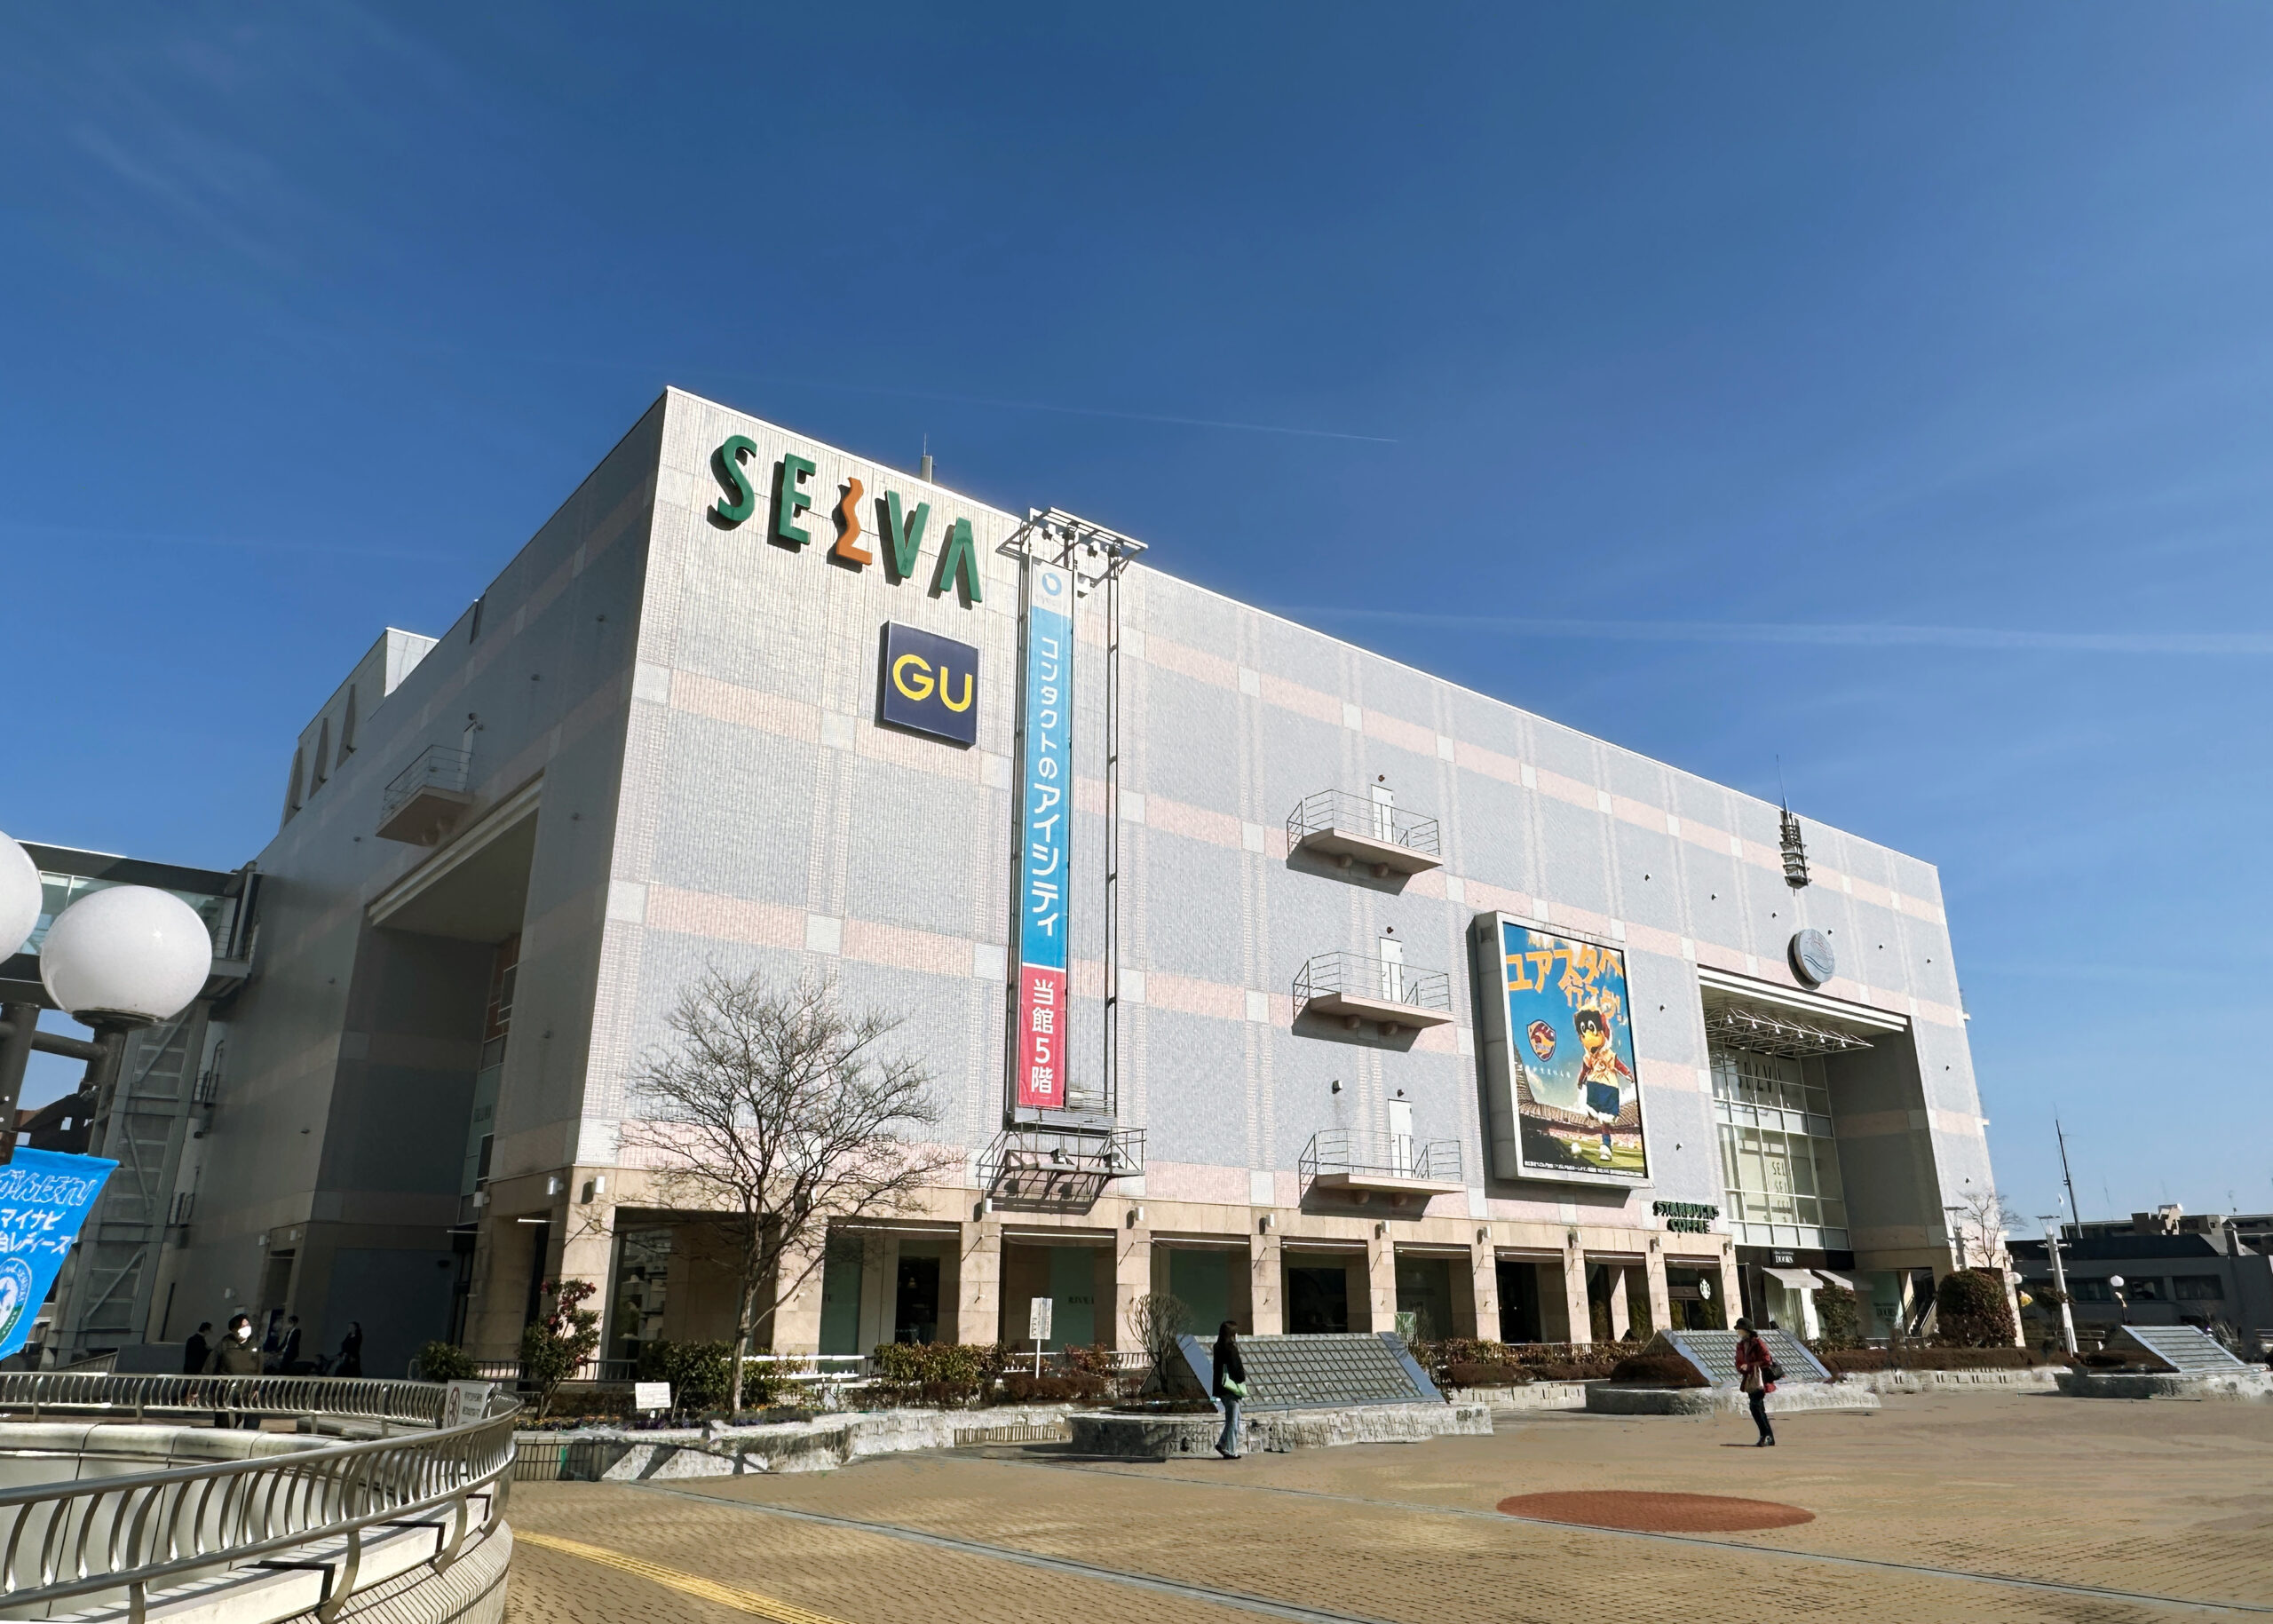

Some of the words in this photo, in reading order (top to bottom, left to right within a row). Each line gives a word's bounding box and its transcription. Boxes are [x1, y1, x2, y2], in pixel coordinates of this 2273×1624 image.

[716, 434, 983, 604] SELVA
[892, 654, 973, 713] GU
[1032, 636, 1060, 937] コンタクトのアイシティ
[1506, 943, 1624, 994] ユアスタへ
[1031, 978, 1054, 1093] 当館5階
[1, 1208, 66, 1231] マイナビ
[1652, 1200, 1719, 1220] STARBUCKS
[1667, 1219, 1710, 1233] COFFEE
